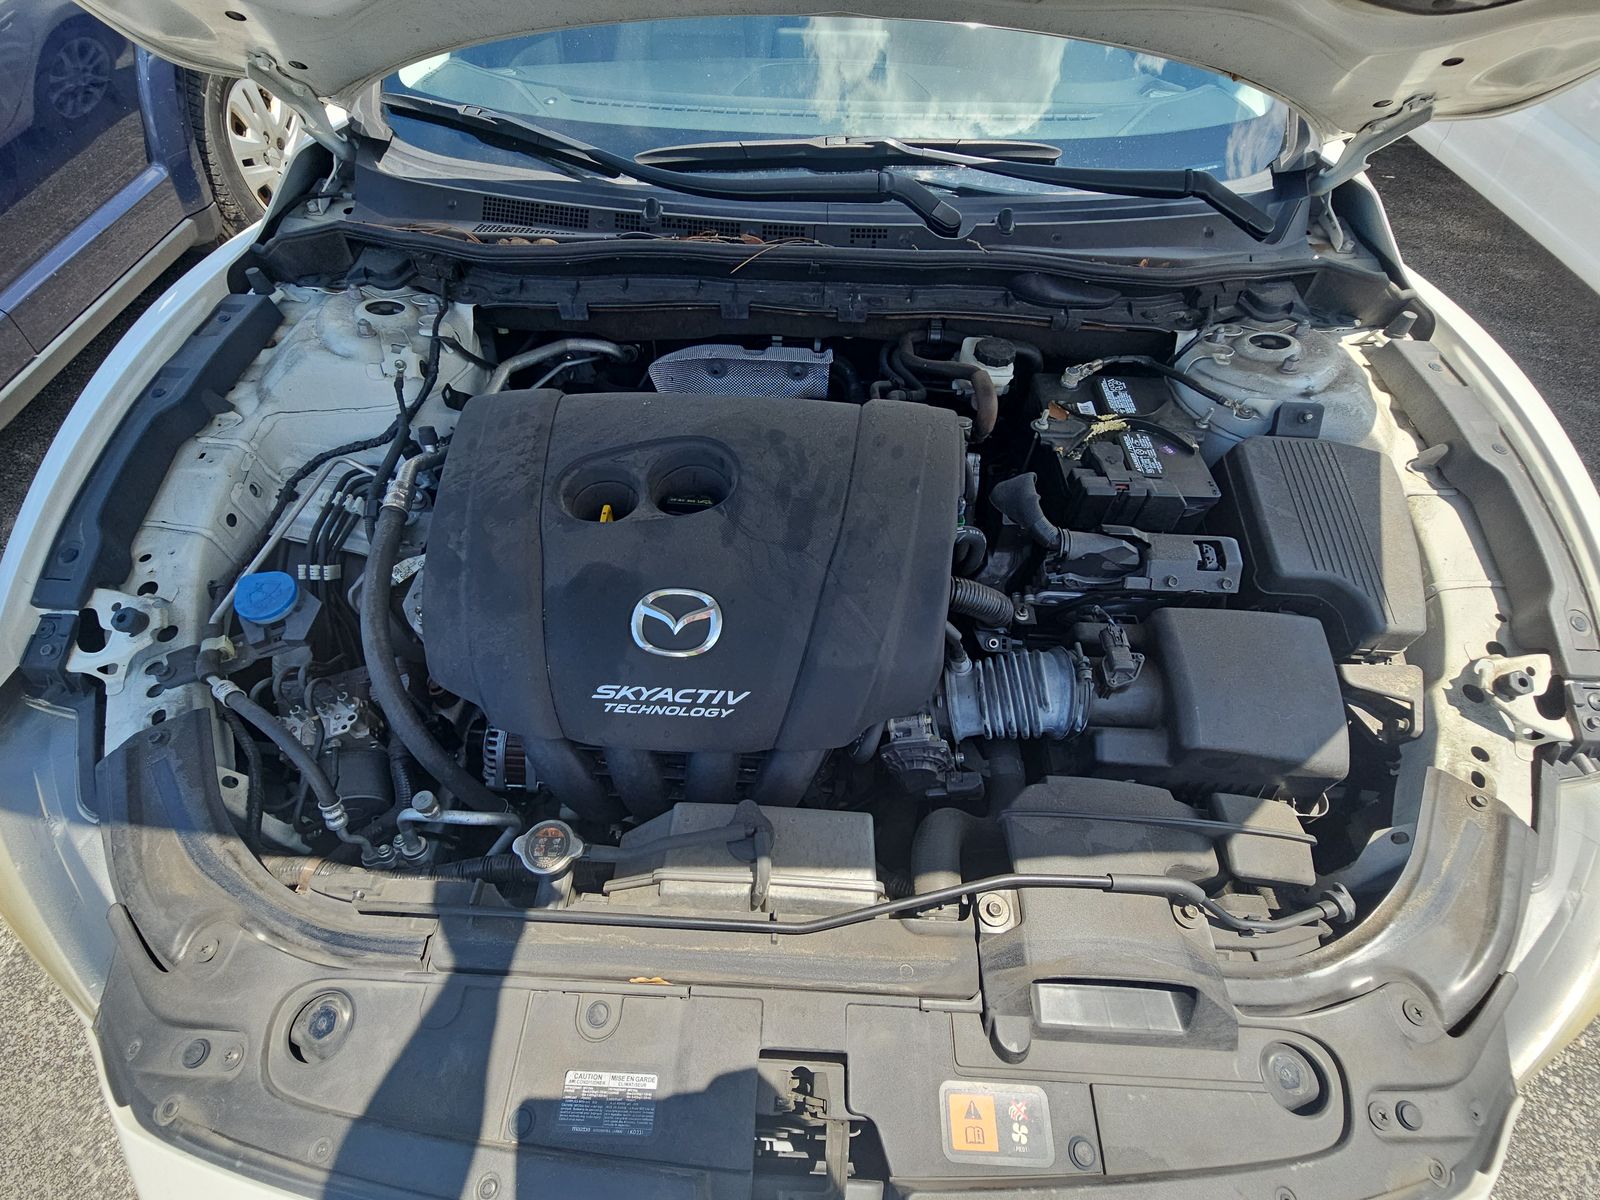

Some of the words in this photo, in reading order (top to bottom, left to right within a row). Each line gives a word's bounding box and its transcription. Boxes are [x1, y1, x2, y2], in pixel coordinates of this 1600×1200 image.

[591, 684, 751, 706] SKYACTIV
[604, 702, 735, 718] TECHNOLOGY
[573, 1072, 603, 1080] CAUTION
